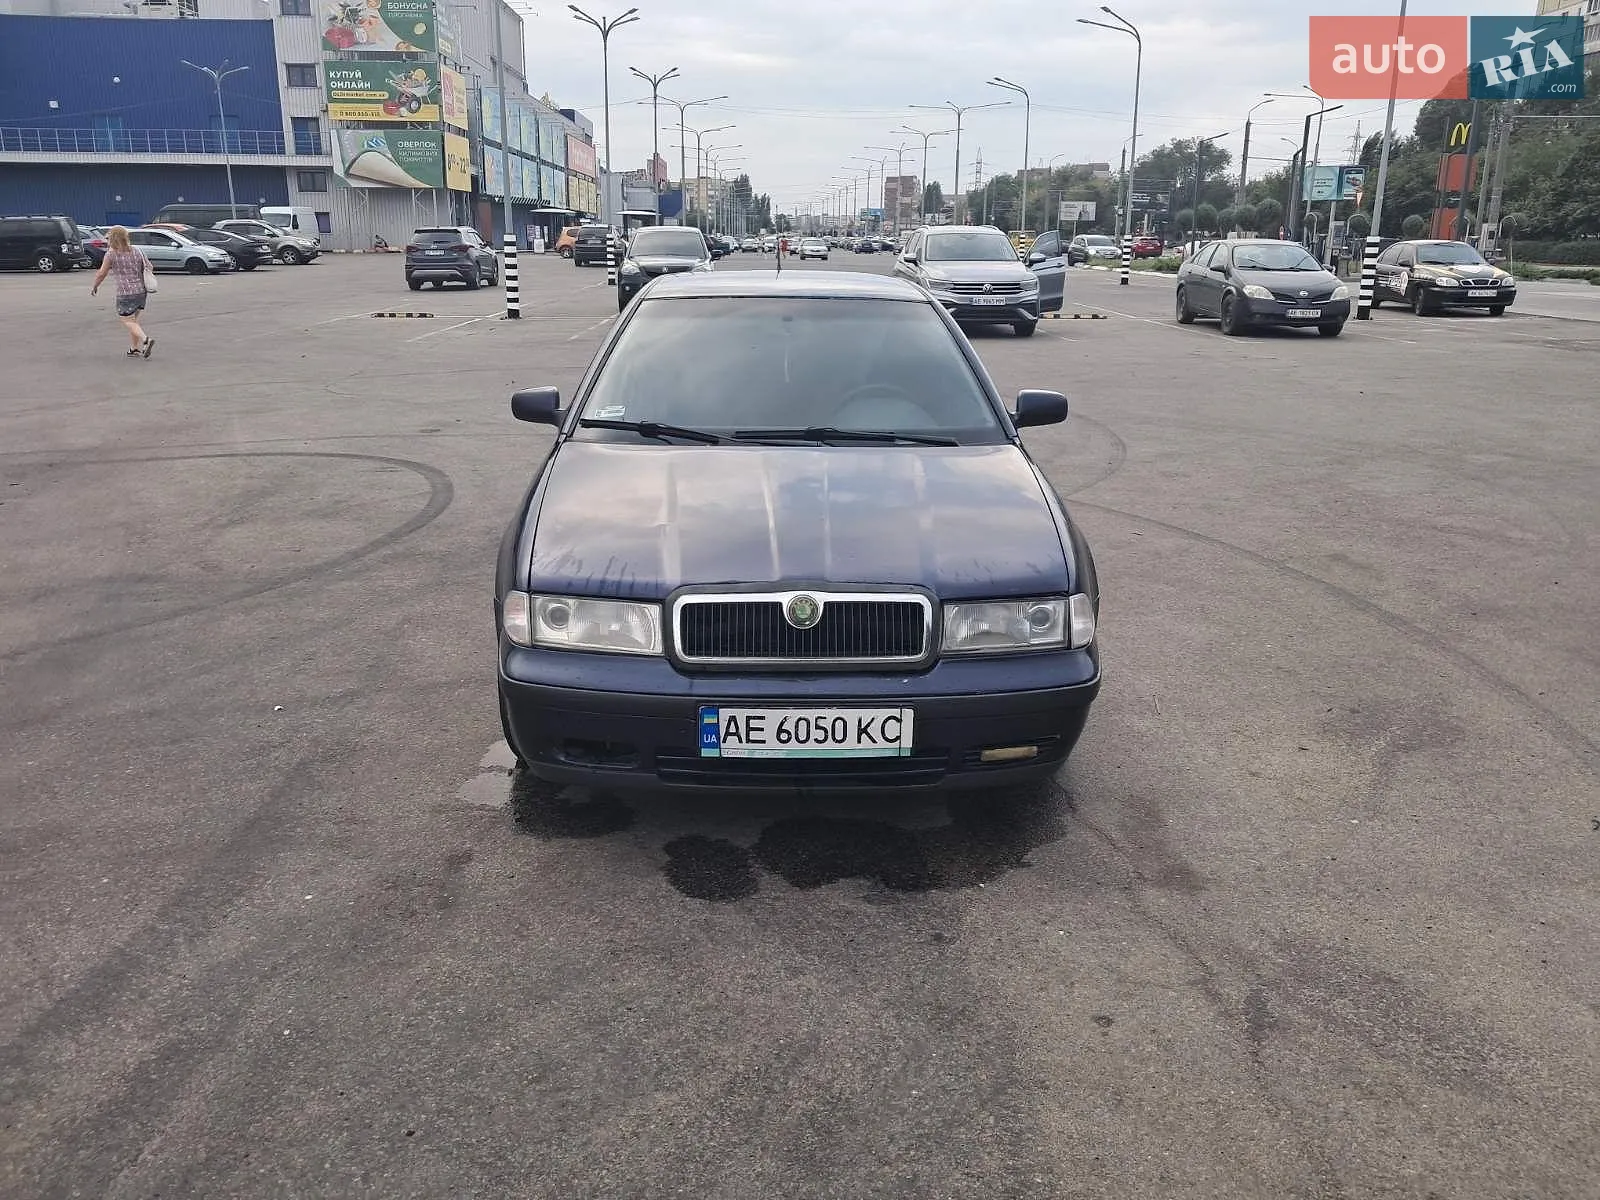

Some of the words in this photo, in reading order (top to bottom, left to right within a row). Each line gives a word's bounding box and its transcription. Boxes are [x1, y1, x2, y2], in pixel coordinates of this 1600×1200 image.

[387, 2, 428, 10] БОНУСНА
[329, 69, 363, 79] КУПУЙ
[330, 80, 371, 89] ОНЛАЙН
[722, 715, 766, 744] AE
[776, 715, 848, 745] 6050
[857, 715, 902, 744] KC
[703, 734, 718, 743] UA
